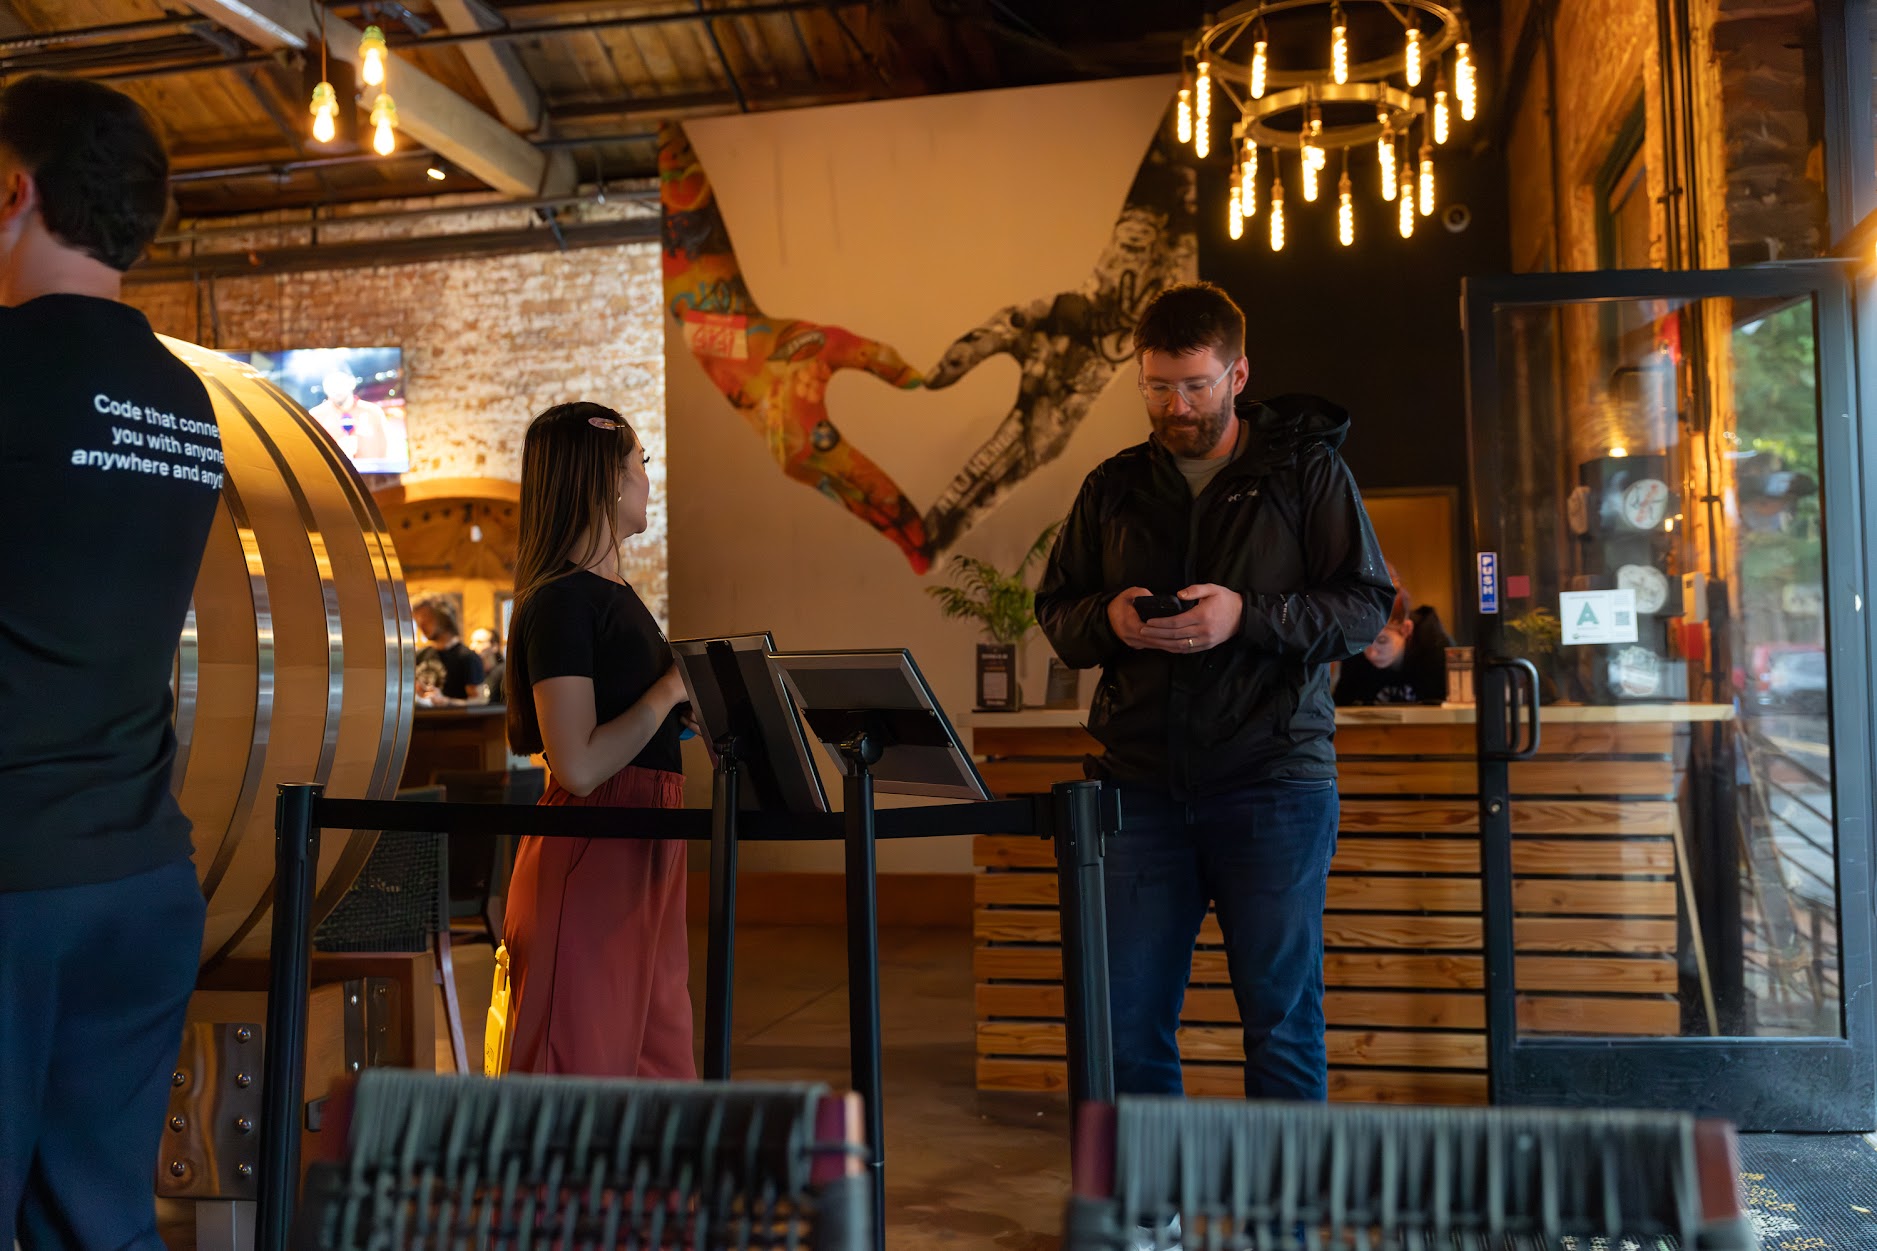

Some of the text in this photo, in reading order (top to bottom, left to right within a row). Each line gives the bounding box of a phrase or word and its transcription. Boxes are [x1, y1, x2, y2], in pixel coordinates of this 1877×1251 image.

[94, 393, 220, 439] Code that conne
[112, 426, 143, 446] you
[146, 433, 182, 454] with
[71, 449, 224, 489] anywhere and anyt
[1482, 556, 1494, 595] PUSH
[1577, 601, 1599, 625] A
